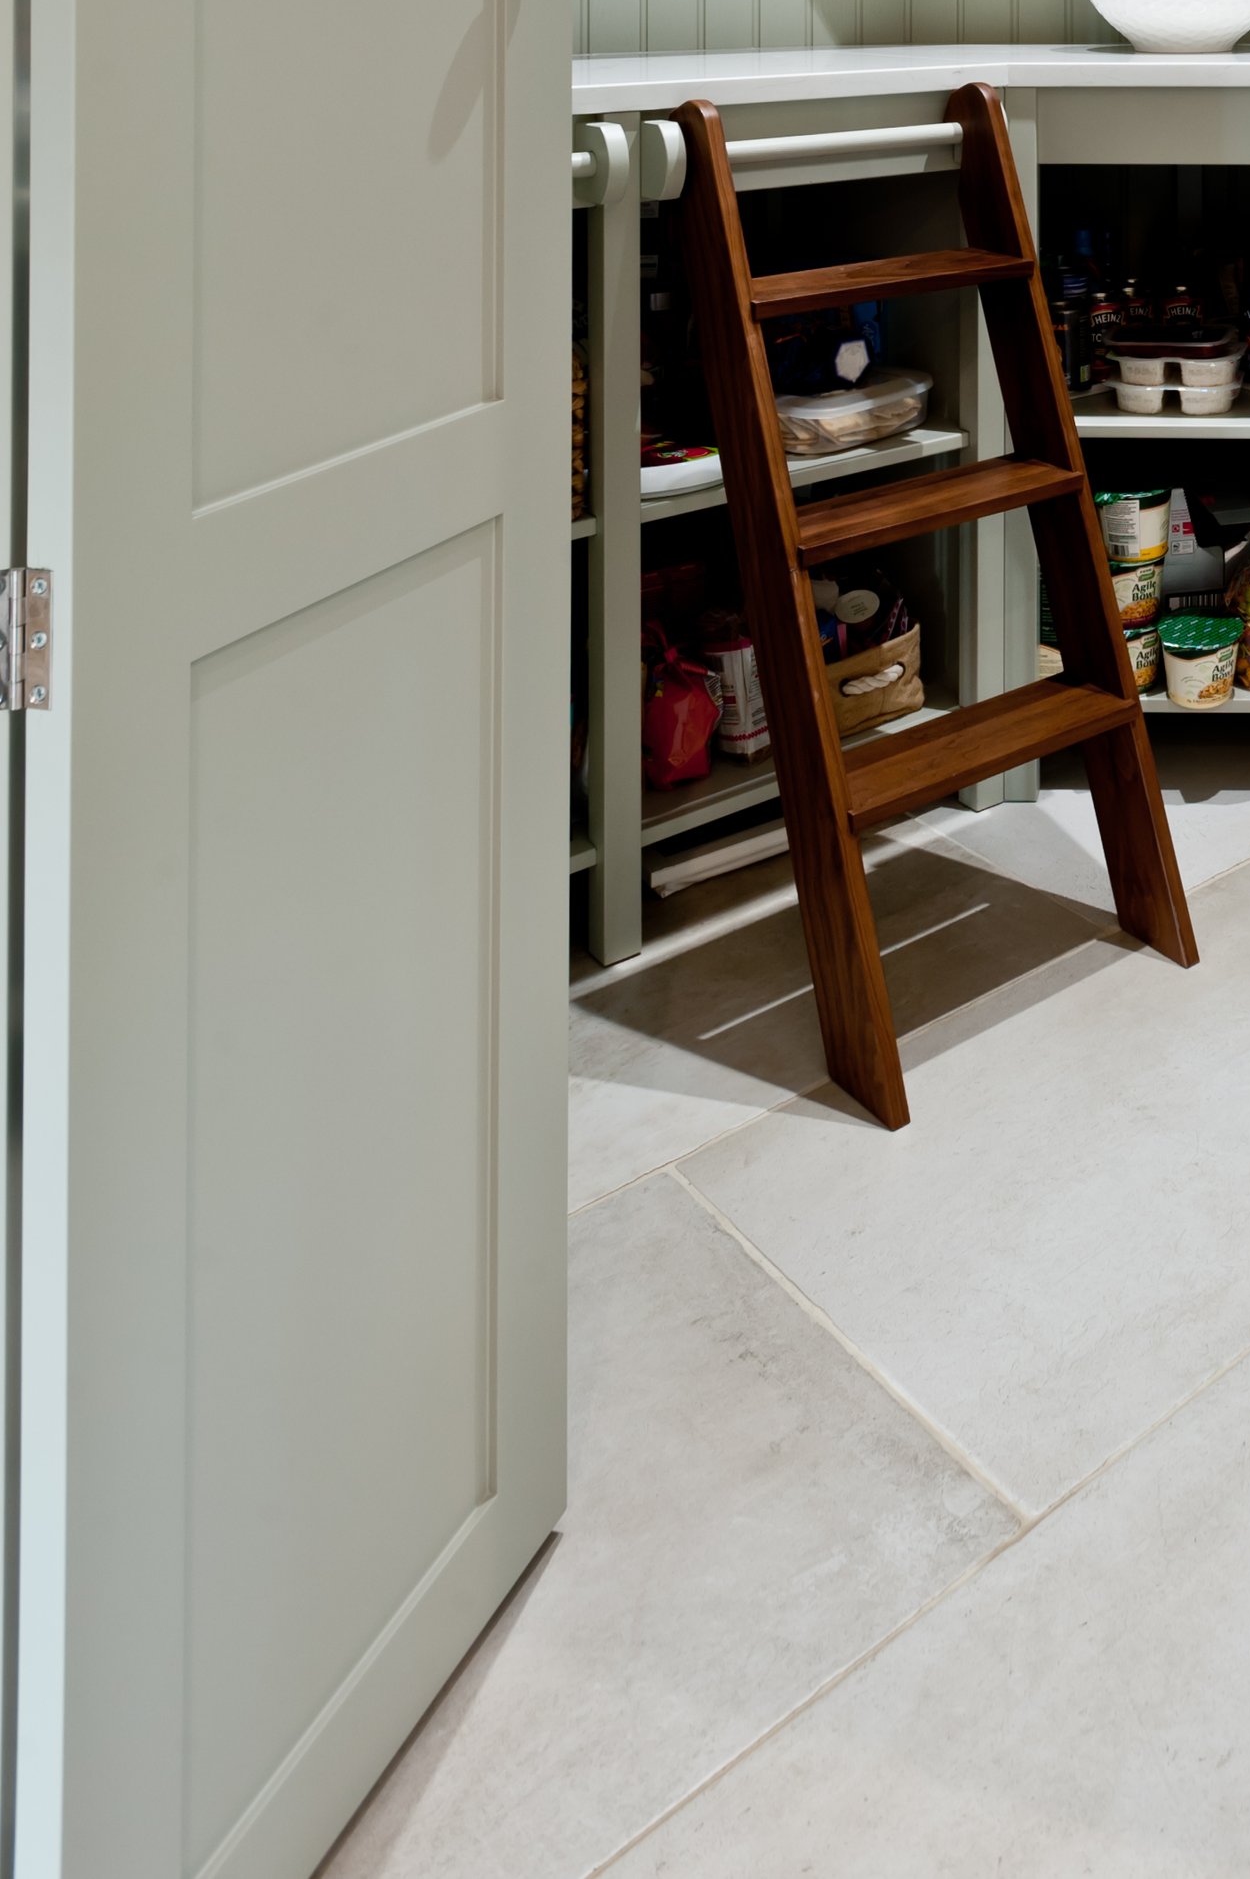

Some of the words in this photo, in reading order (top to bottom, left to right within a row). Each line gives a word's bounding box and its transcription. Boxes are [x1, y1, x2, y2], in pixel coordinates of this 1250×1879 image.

[1129, 307, 1149, 316] EINZ
[1170, 306, 1196, 316] HEINZ
[1095, 313, 1121, 325] HEINZ
[1132, 581, 1156, 596] Agile
[1132, 587, 1156, 602] Bowl
[1212, 660, 1235, 676] Agile
[1212, 667, 1235, 682] Bowl
